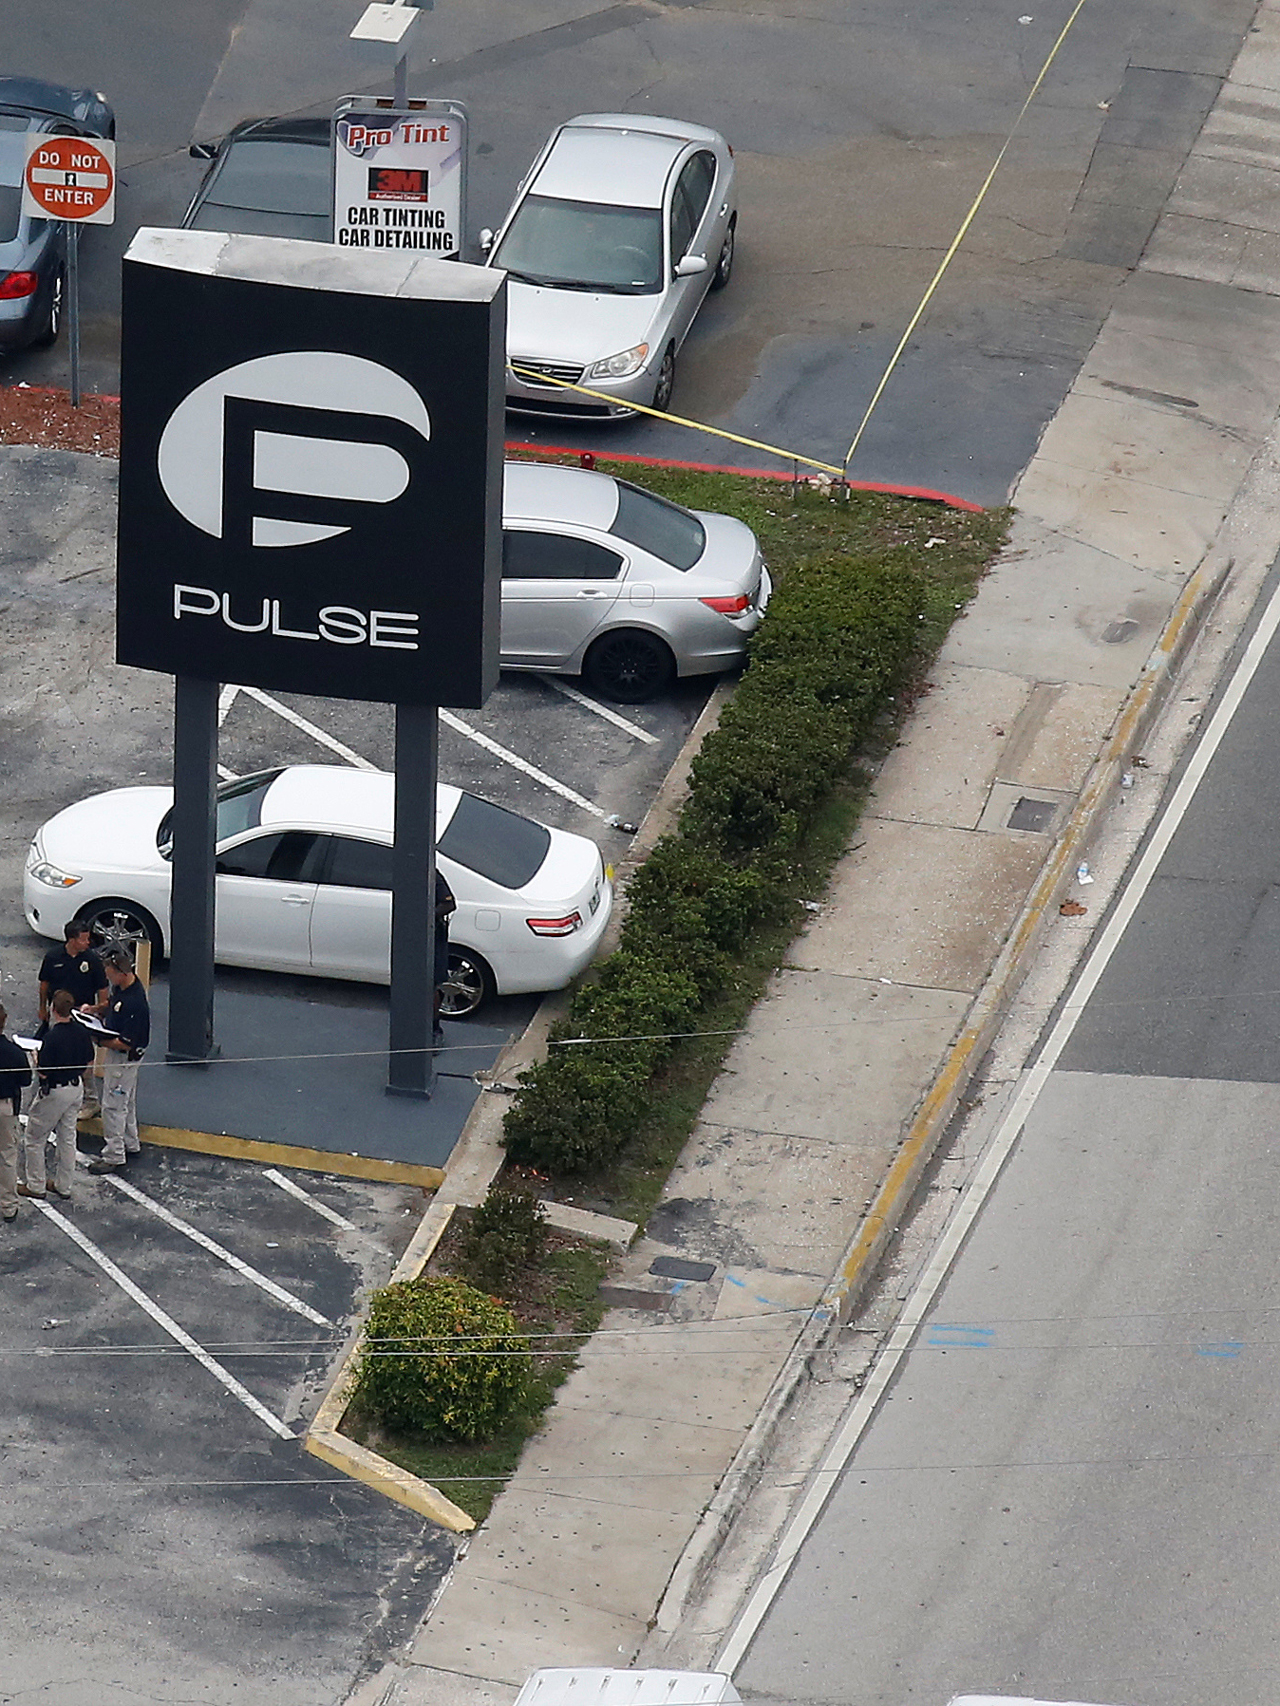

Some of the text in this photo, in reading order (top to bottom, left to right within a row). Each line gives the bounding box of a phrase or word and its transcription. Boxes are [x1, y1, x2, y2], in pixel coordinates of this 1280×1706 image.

[348, 124, 450, 147] Pro Tint
[39, 151, 101, 169] DO NOT
[377, 169, 423, 192] 3M
[44, 188, 94, 206] ENTER
[348, 206, 445, 229] CAR TINTING
[339, 228, 453, 251] CAR DETAILING
[174, 583, 419, 650] PULSE
